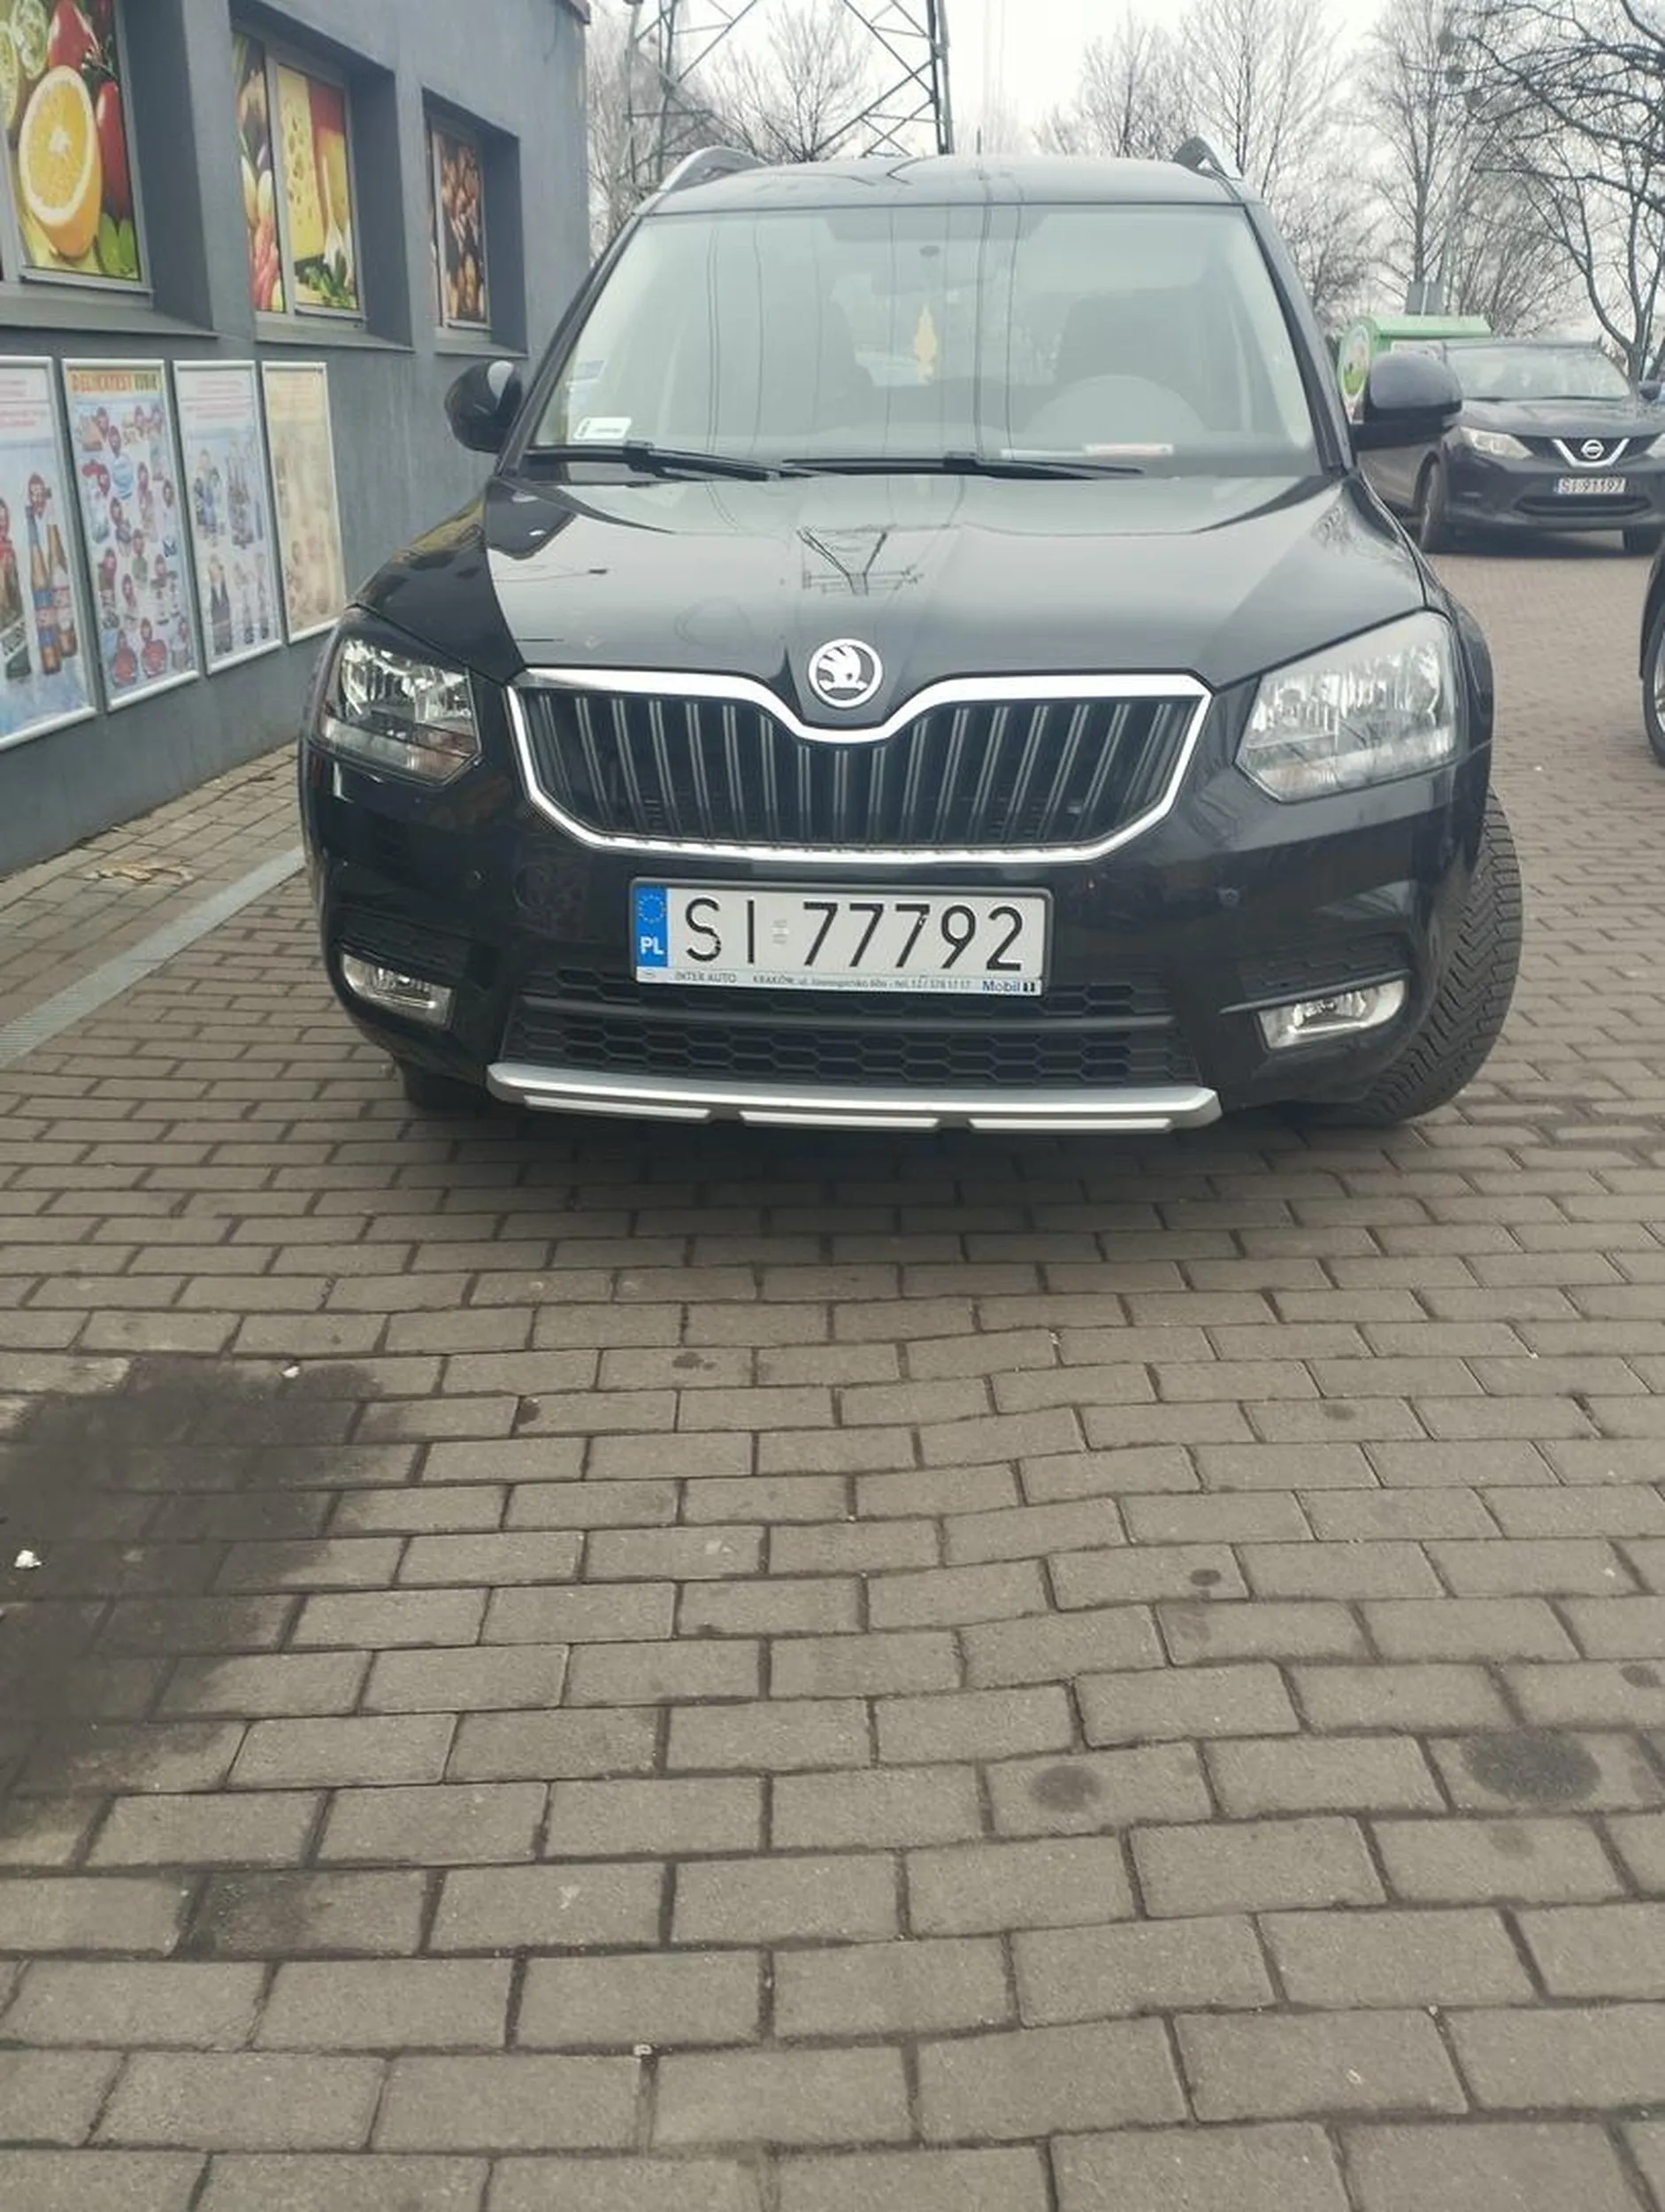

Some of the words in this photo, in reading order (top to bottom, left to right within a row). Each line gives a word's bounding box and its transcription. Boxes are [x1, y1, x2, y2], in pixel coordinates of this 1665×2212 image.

[685, 897, 755, 964] SI
[802, 901, 1023, 972] 77792
[640, 936, 664, 956] PL
[709, 973, 737, 984] AUTO
[982, 980, 1021, 993] Mobil
